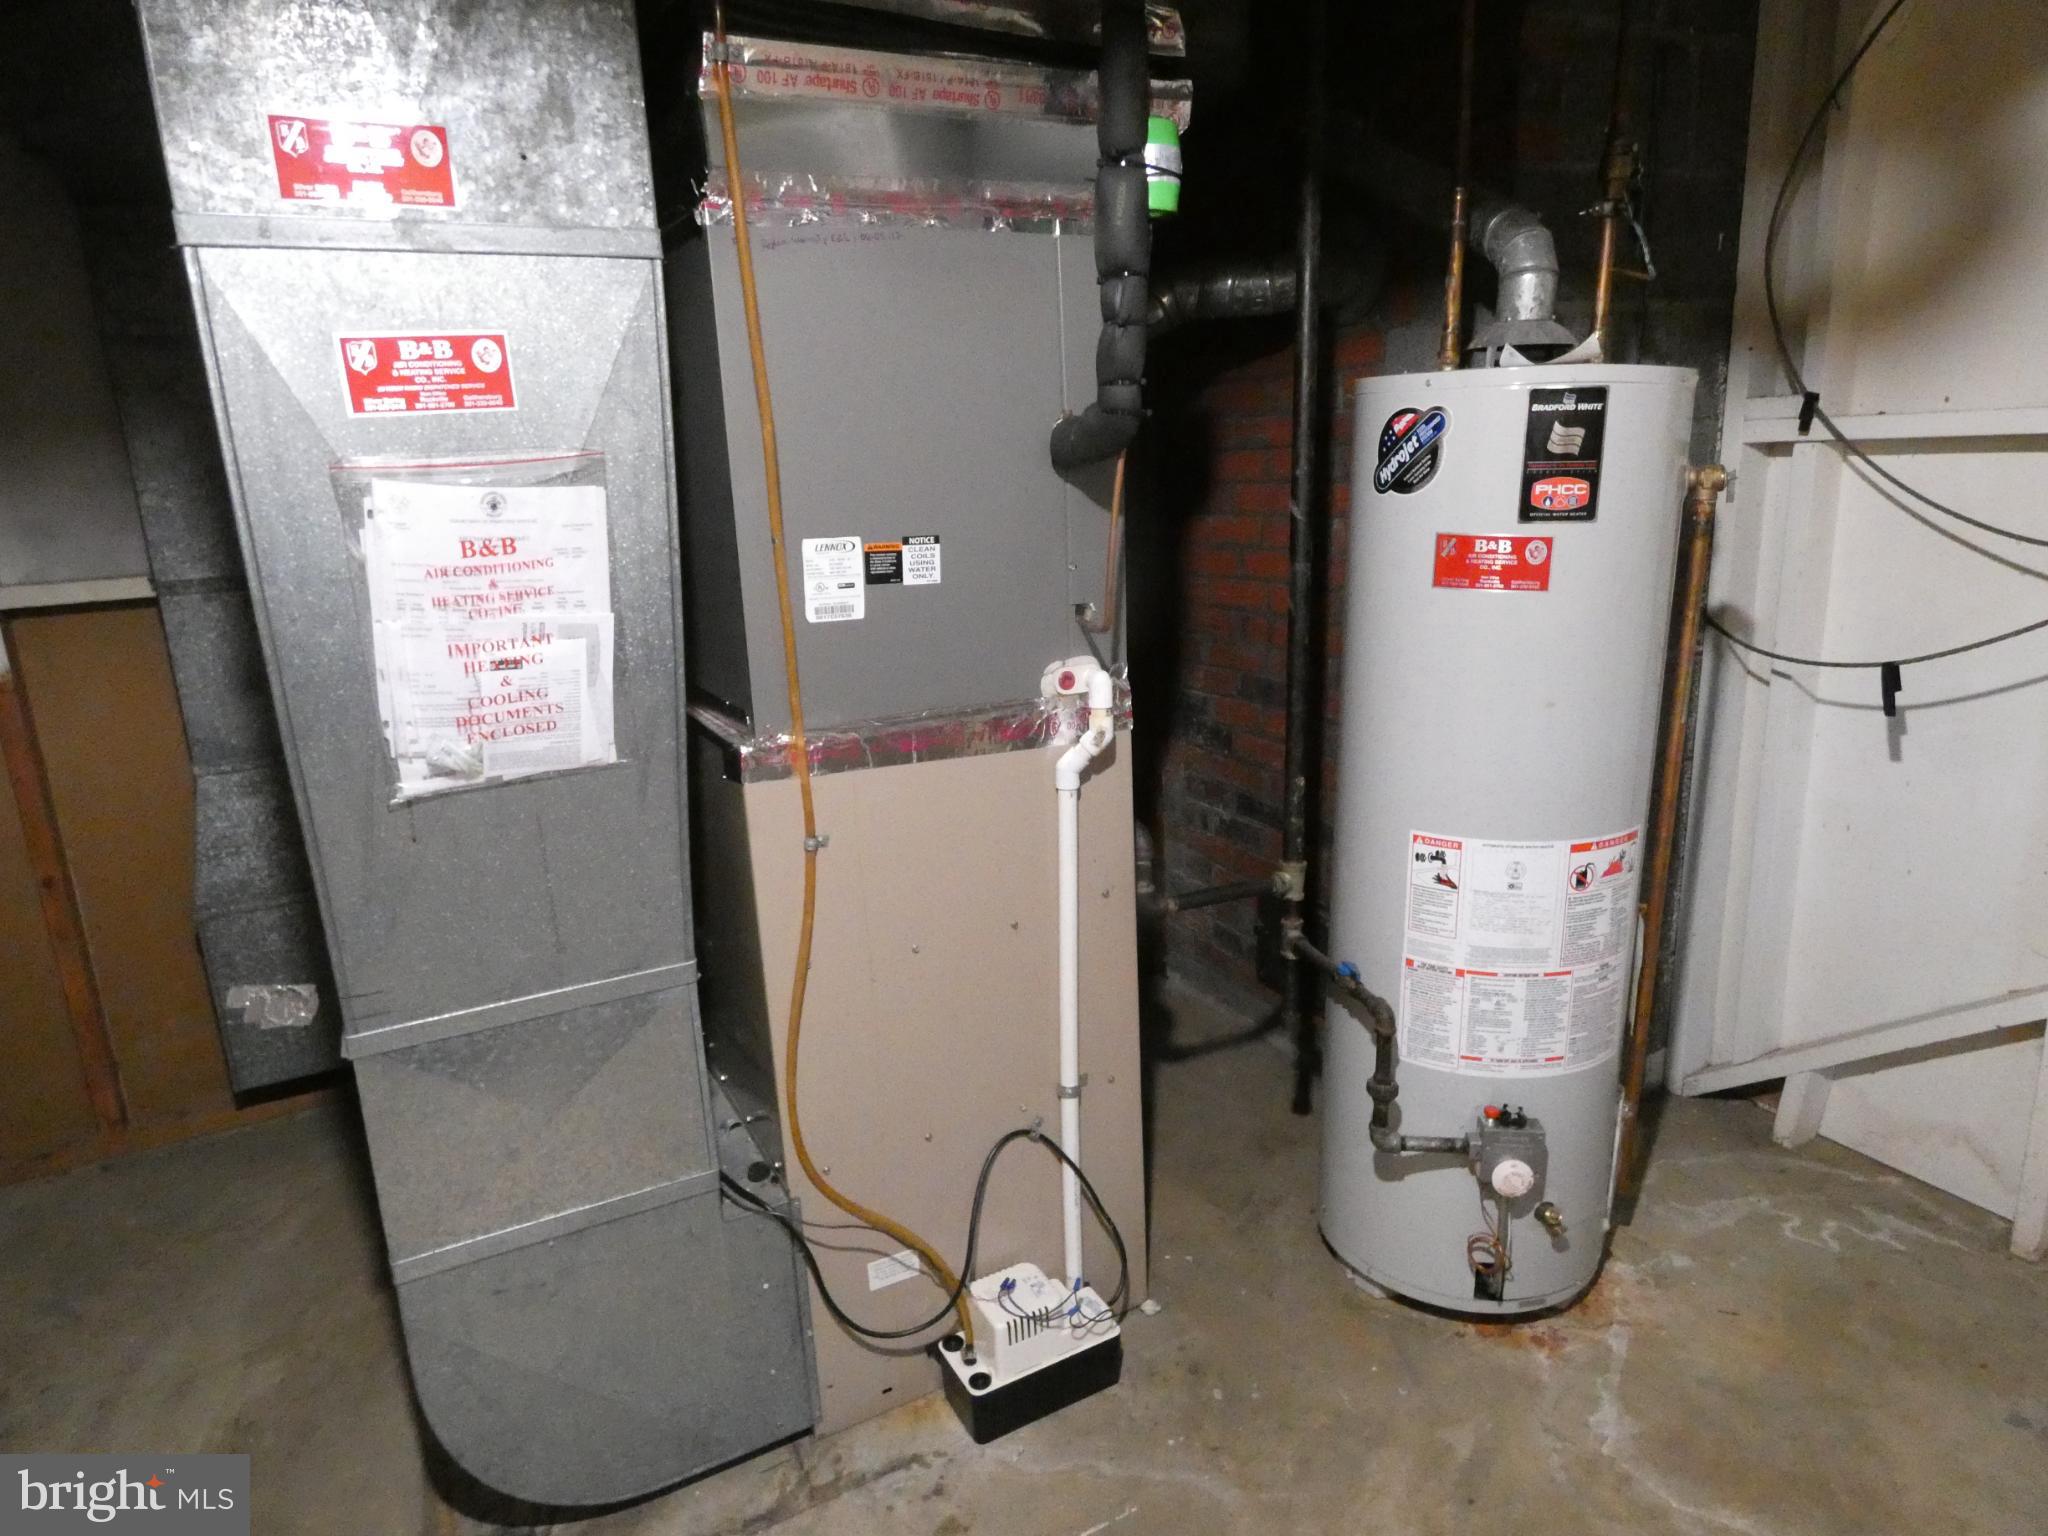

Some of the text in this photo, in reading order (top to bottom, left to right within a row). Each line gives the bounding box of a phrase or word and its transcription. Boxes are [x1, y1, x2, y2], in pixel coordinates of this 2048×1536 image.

[756, 70, 777, 85] 100
[781, 73, 798, 88] AF
[805, 74, 858, 94] Shurtape
[889, 85, 907, 99] 100
[911, 88, 926, 101] AF
[932, 88, 980, 107] Shurtape
[397, 340, 454, 361] B&B
[400, 368, 433, 376] HEATING
[434, 367, 467, 376] SERVICE
[408, 360, 464, 369] CONDITIONING
[1531, 402, 1604, 412] BRADFORD WHITE
[1535, 484, 1587, 495] PHCC
[460, 536, 518, 560] B&B
[815, 542, 849, 553] LENNOX
[909, 536, 935, 545] NOTICE
[1474, 538, 1513, 554] B&B
[910, 552, 936, 560] COILS
[424, 557, 555, 581] AIR CONDITIONING
[488, 577, 500, 591] &
[431, 585, 556, 610] HEATING SERVICE
[447, 632, 556, 661] IMPORTANT
[499, 675, 513, 688] &
[466, 687, 549, 712] COOLING
[455, 703, 564, 731] DOCUMENTS
[466, 719, 558, 745] ENCLOSED
[1424, 837, 1460, 849] DANGER
